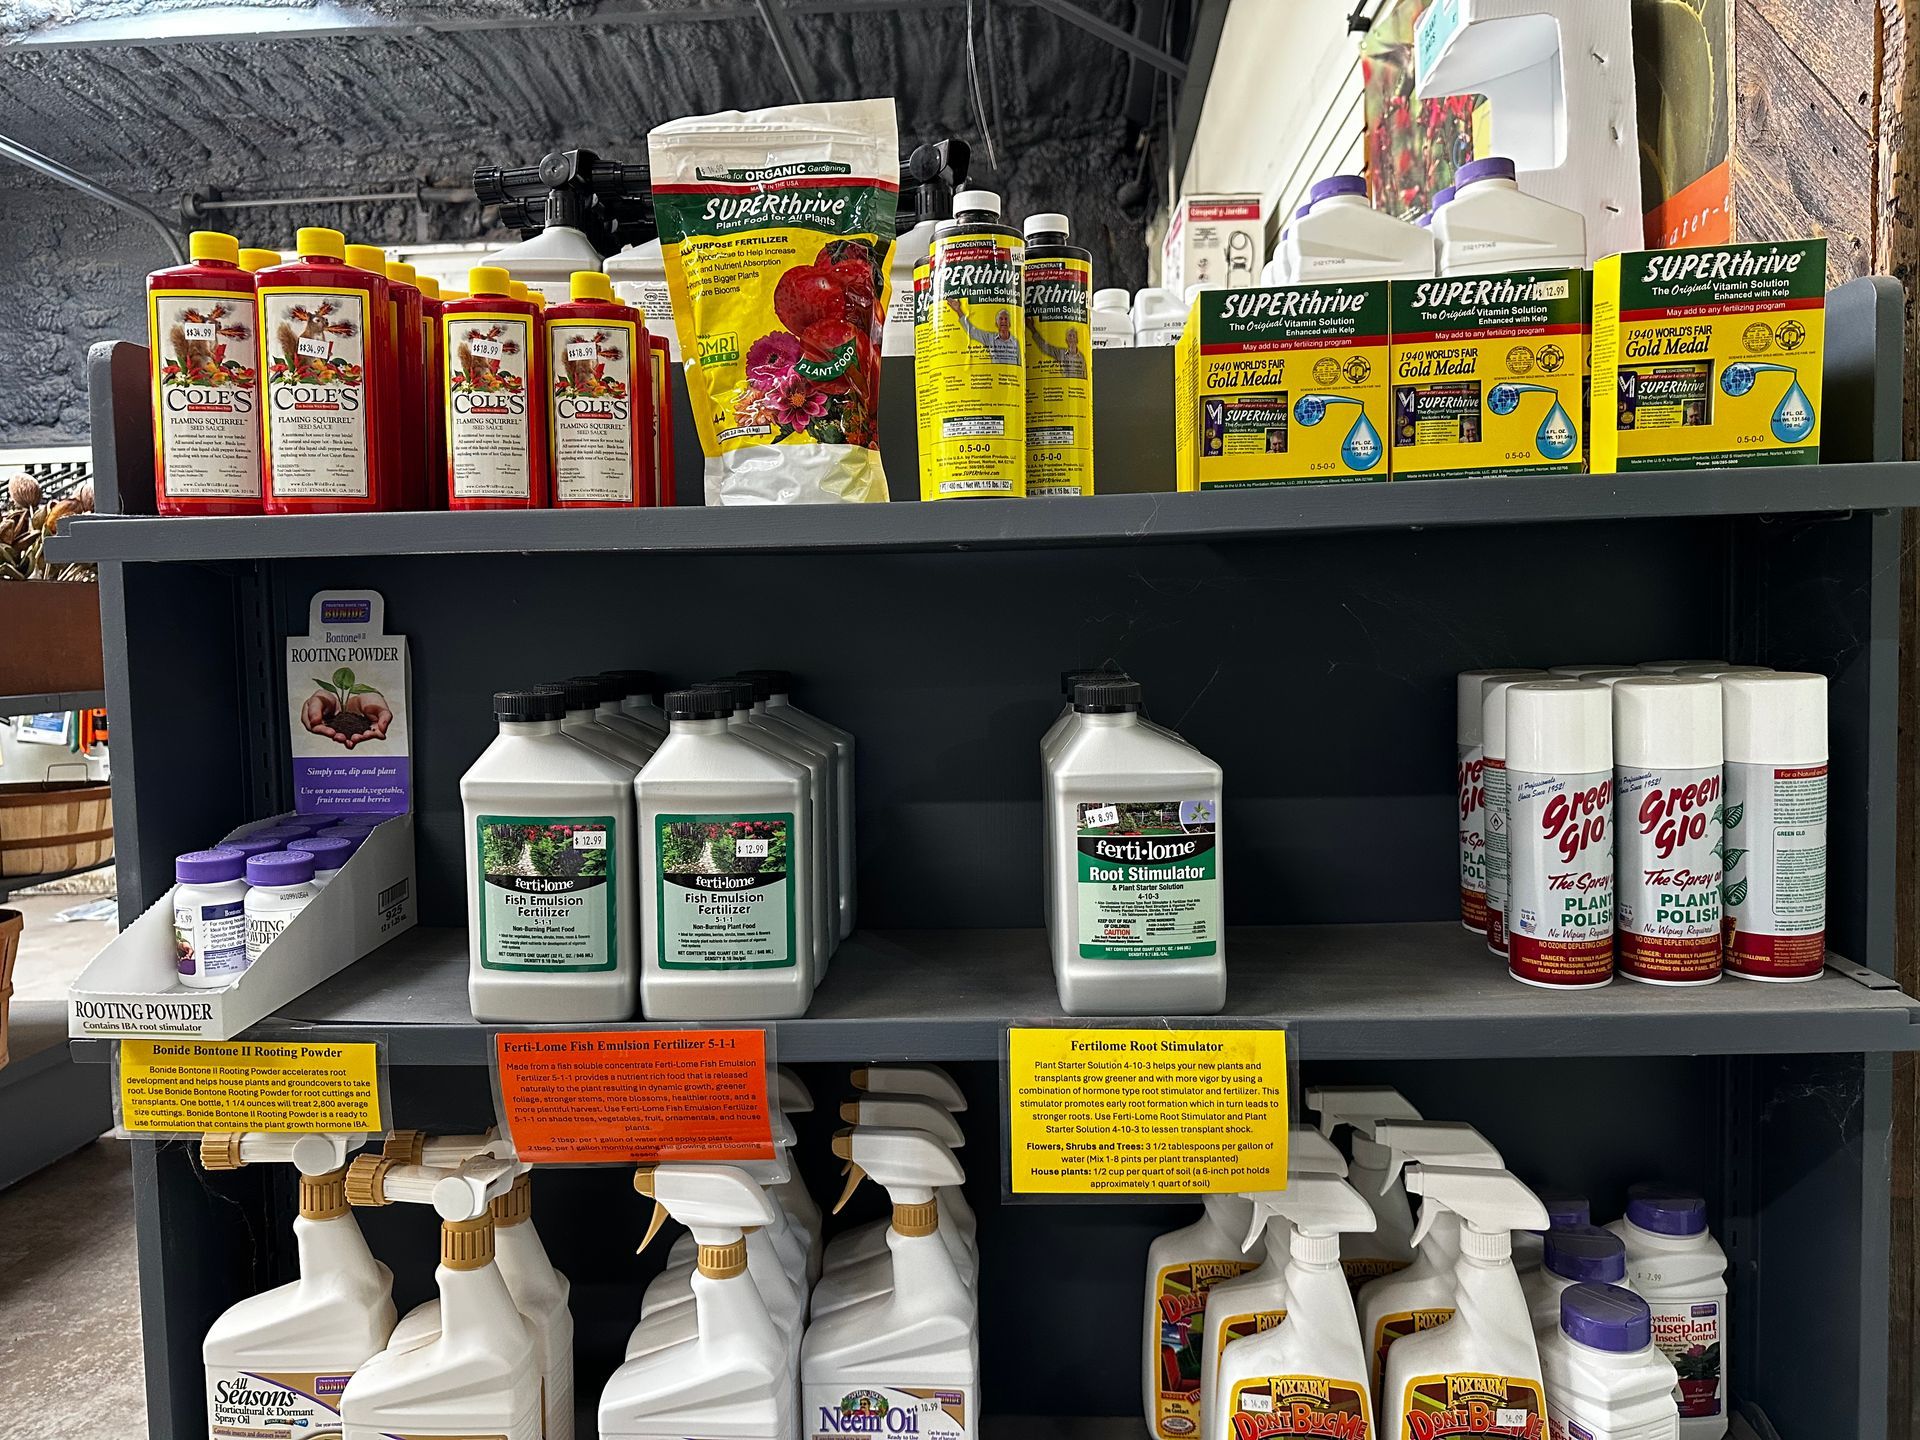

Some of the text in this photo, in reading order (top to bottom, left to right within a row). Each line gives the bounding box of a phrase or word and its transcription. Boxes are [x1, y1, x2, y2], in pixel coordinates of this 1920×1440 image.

[745, 163, 846, 181] ORGANIC Gardening
[702, 192, 846, 222] SUPERthrive
[716, 219, 742, 230] Plant
[743, 214, 768, 225] Food
[788, 214, 803, 223] All
[805, 214, 835, 226] Plants
[735, 236, 788, 246] FERTILIZER
[955, 240, 992, 249] CONCENTRATE
[1642, 247, 1801, 282] SUPERthrive
[961, 288, 992, 296] Vitamin
[1546, 287, 1564, 297] 12.99
[1652, 279, 1789, 297] The Original Vitamin Solution
[1714, 289, 1789, 300] Enhanced with Kelp
[1220, 288, 1365, 319] SUPERthrive
[1667, 308, 1682, 316] May
[1708, 306, 1721, 314] any
[1723, 304, 1756, 313] fertilizing
[1757, 302, 1786, 311] program
[1229, 318, 1355, 332] The Original Vitamin Solution
[1286, 328, 1321, 336] Enhanced
[1339, 326, 1355, 335] Kelp
[1627, 325, 1712, 339] 1940 WORLD'S FAIR
[1626, 336, 1709, 357] Gold Medal
[799, 346, 855, 377] PLANT FOOD
[1208, 359, 1285, 372] 1940 WORLD'S FAIR
[1207, 370, 1283, 388] Gold Medal
[168, 388, 252, 412] COLE'S
[274, 387, 358, 411] COLE'S
[455, 394, 524, 414] COLE'S
[558, 400, 627, 419] COLE'S
[959, 443, 990, 453] 0.5-0-0
[1033, 453, 1062, 462] 0.5-0-0
[292, 647, 399, 663] ROOTING POWDER
[307, 767, 332, 777] Simply
[334, 768, 347, 776] cut,
[349, 767, 360, 776] dip
[377, 767, 396, 777] plant
[1098, 812, 1114, 822] 8.99
[583, 836, 601, 845] 12.99
[746, 845, 764, 853] 12.99
[1090, 866, 1205, 881] Root Stimulator
[1644, 869, 1711, 891] The Spray
[505, 895, 583, 905] Fish Emulsion
[686, 893, 764, 903] Fish Emulsion
[1661, 891, 1718, 907] PLANT
[518, 907, 570, 917] Fertilizer
[698, 904, 751, 915] Fertilizer
[1657, 906, 1719, 924] POLISH
[76, 1001, 213, 1020] ROOTING POWDER
[83, 1021, 119, 1030] Contains
[122, 1022, 137, 1030] IBA
[159, 1023, 202, 1031] stimulator
[153, 1044, 342, 1059] Bonide Bontone II Rooting Powder
[504, 1039, 736, 1053] Ferti-Lome Fish Emulsion Fertilizer 5-1-1
[1071, 1040, 1223, 1052] Fertilome Root Stimulator
[1035, 1061, 1056, 1070] Plant
[1058, 1061, 1086, 1070] Starter
[1087, 1061, 1122, 1070] Solution
[1153, 1061, 1176, 1071] helps
[1217, 1061, 1244, 1071] plants
[1246, 1061, 1261, 1070] and
[1026, 1142, 1144, 1151] Flowers, Shrubs and Trees:
[1655, 1332, 1717, 1342] Insect Control
[230, 1378, 247, 1390] All
[215, 1380, 296, 1407] Seasons
[215, 1404, 265, 1416] Horticultural
[276, 1408, 314, 1416] Dormant
[215, 1415, 250, 1425] Spray Oil
[819, 1407, 919, 1433] Neem Oil
